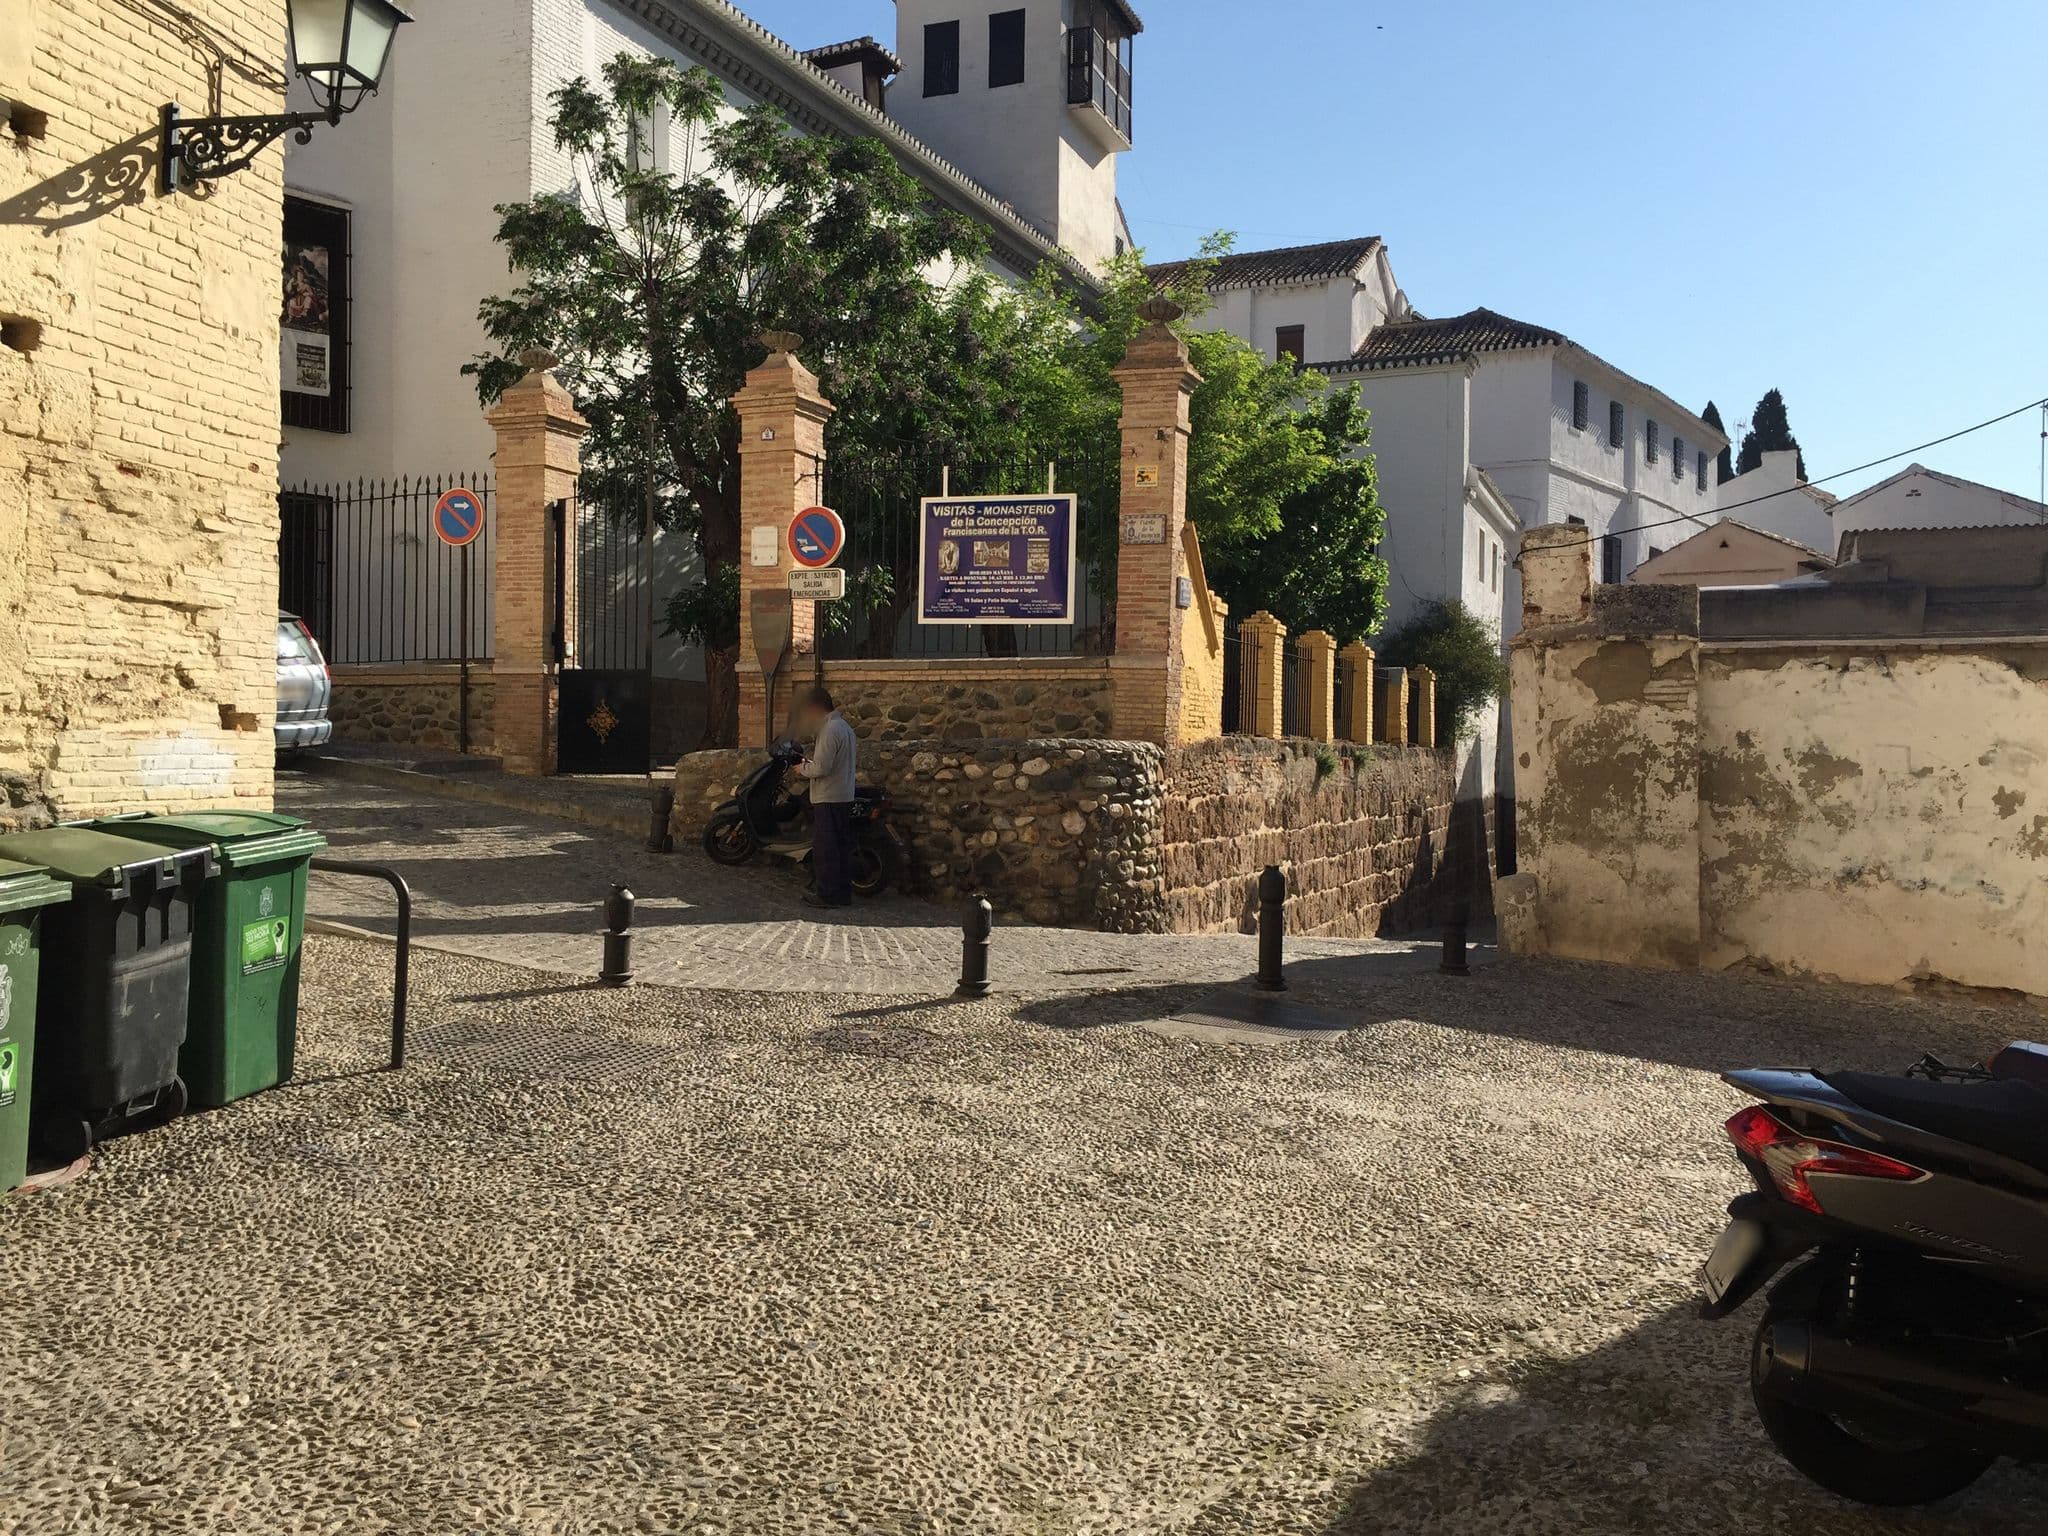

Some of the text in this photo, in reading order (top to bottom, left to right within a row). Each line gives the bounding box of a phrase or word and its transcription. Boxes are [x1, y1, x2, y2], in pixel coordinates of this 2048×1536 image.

[933, 505, 975, 517] VISITAS
[983, 504, 1056, 516] MONASTERIO
[951, 515, 1038, 528] de la Concepción
[943, 525, 1048, 536] Franciscanas de la T.O.R.
